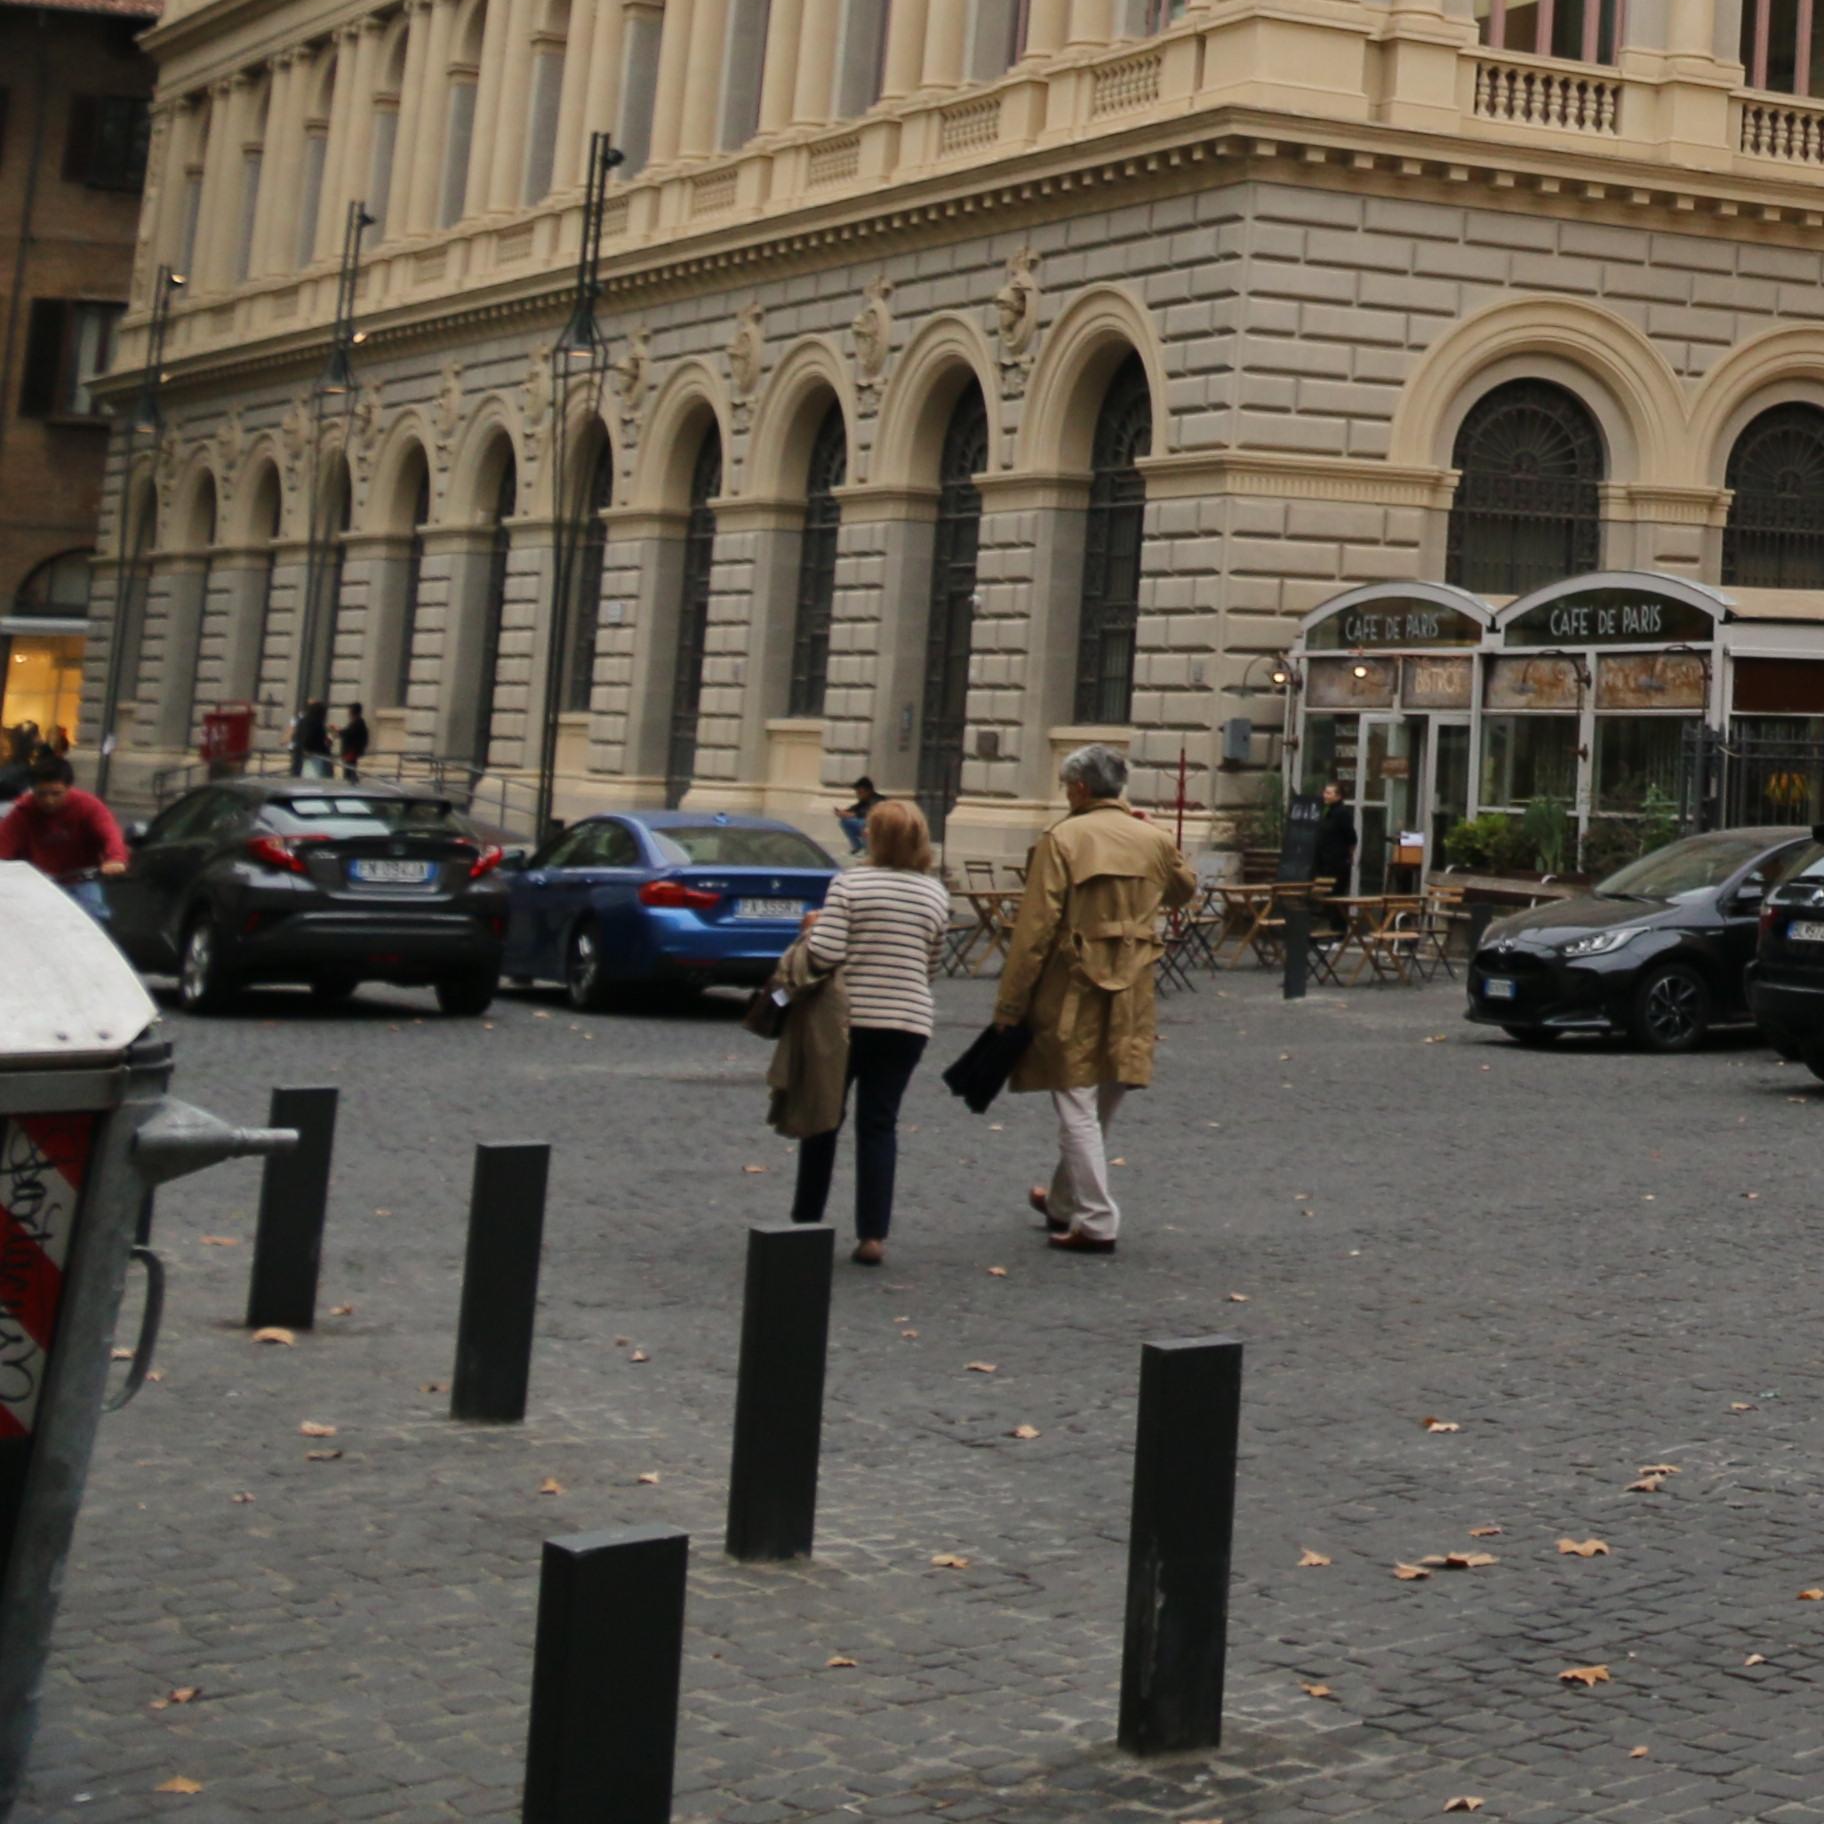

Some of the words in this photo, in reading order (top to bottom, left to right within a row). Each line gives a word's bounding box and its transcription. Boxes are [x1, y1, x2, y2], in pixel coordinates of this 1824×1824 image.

[1385, 616, 1401, 640] DE
[1405, 613, 1439, 639] PARIS
[1598, 608, 1616, 635] DE
[1622, 604, 1662, 634] PARIS
